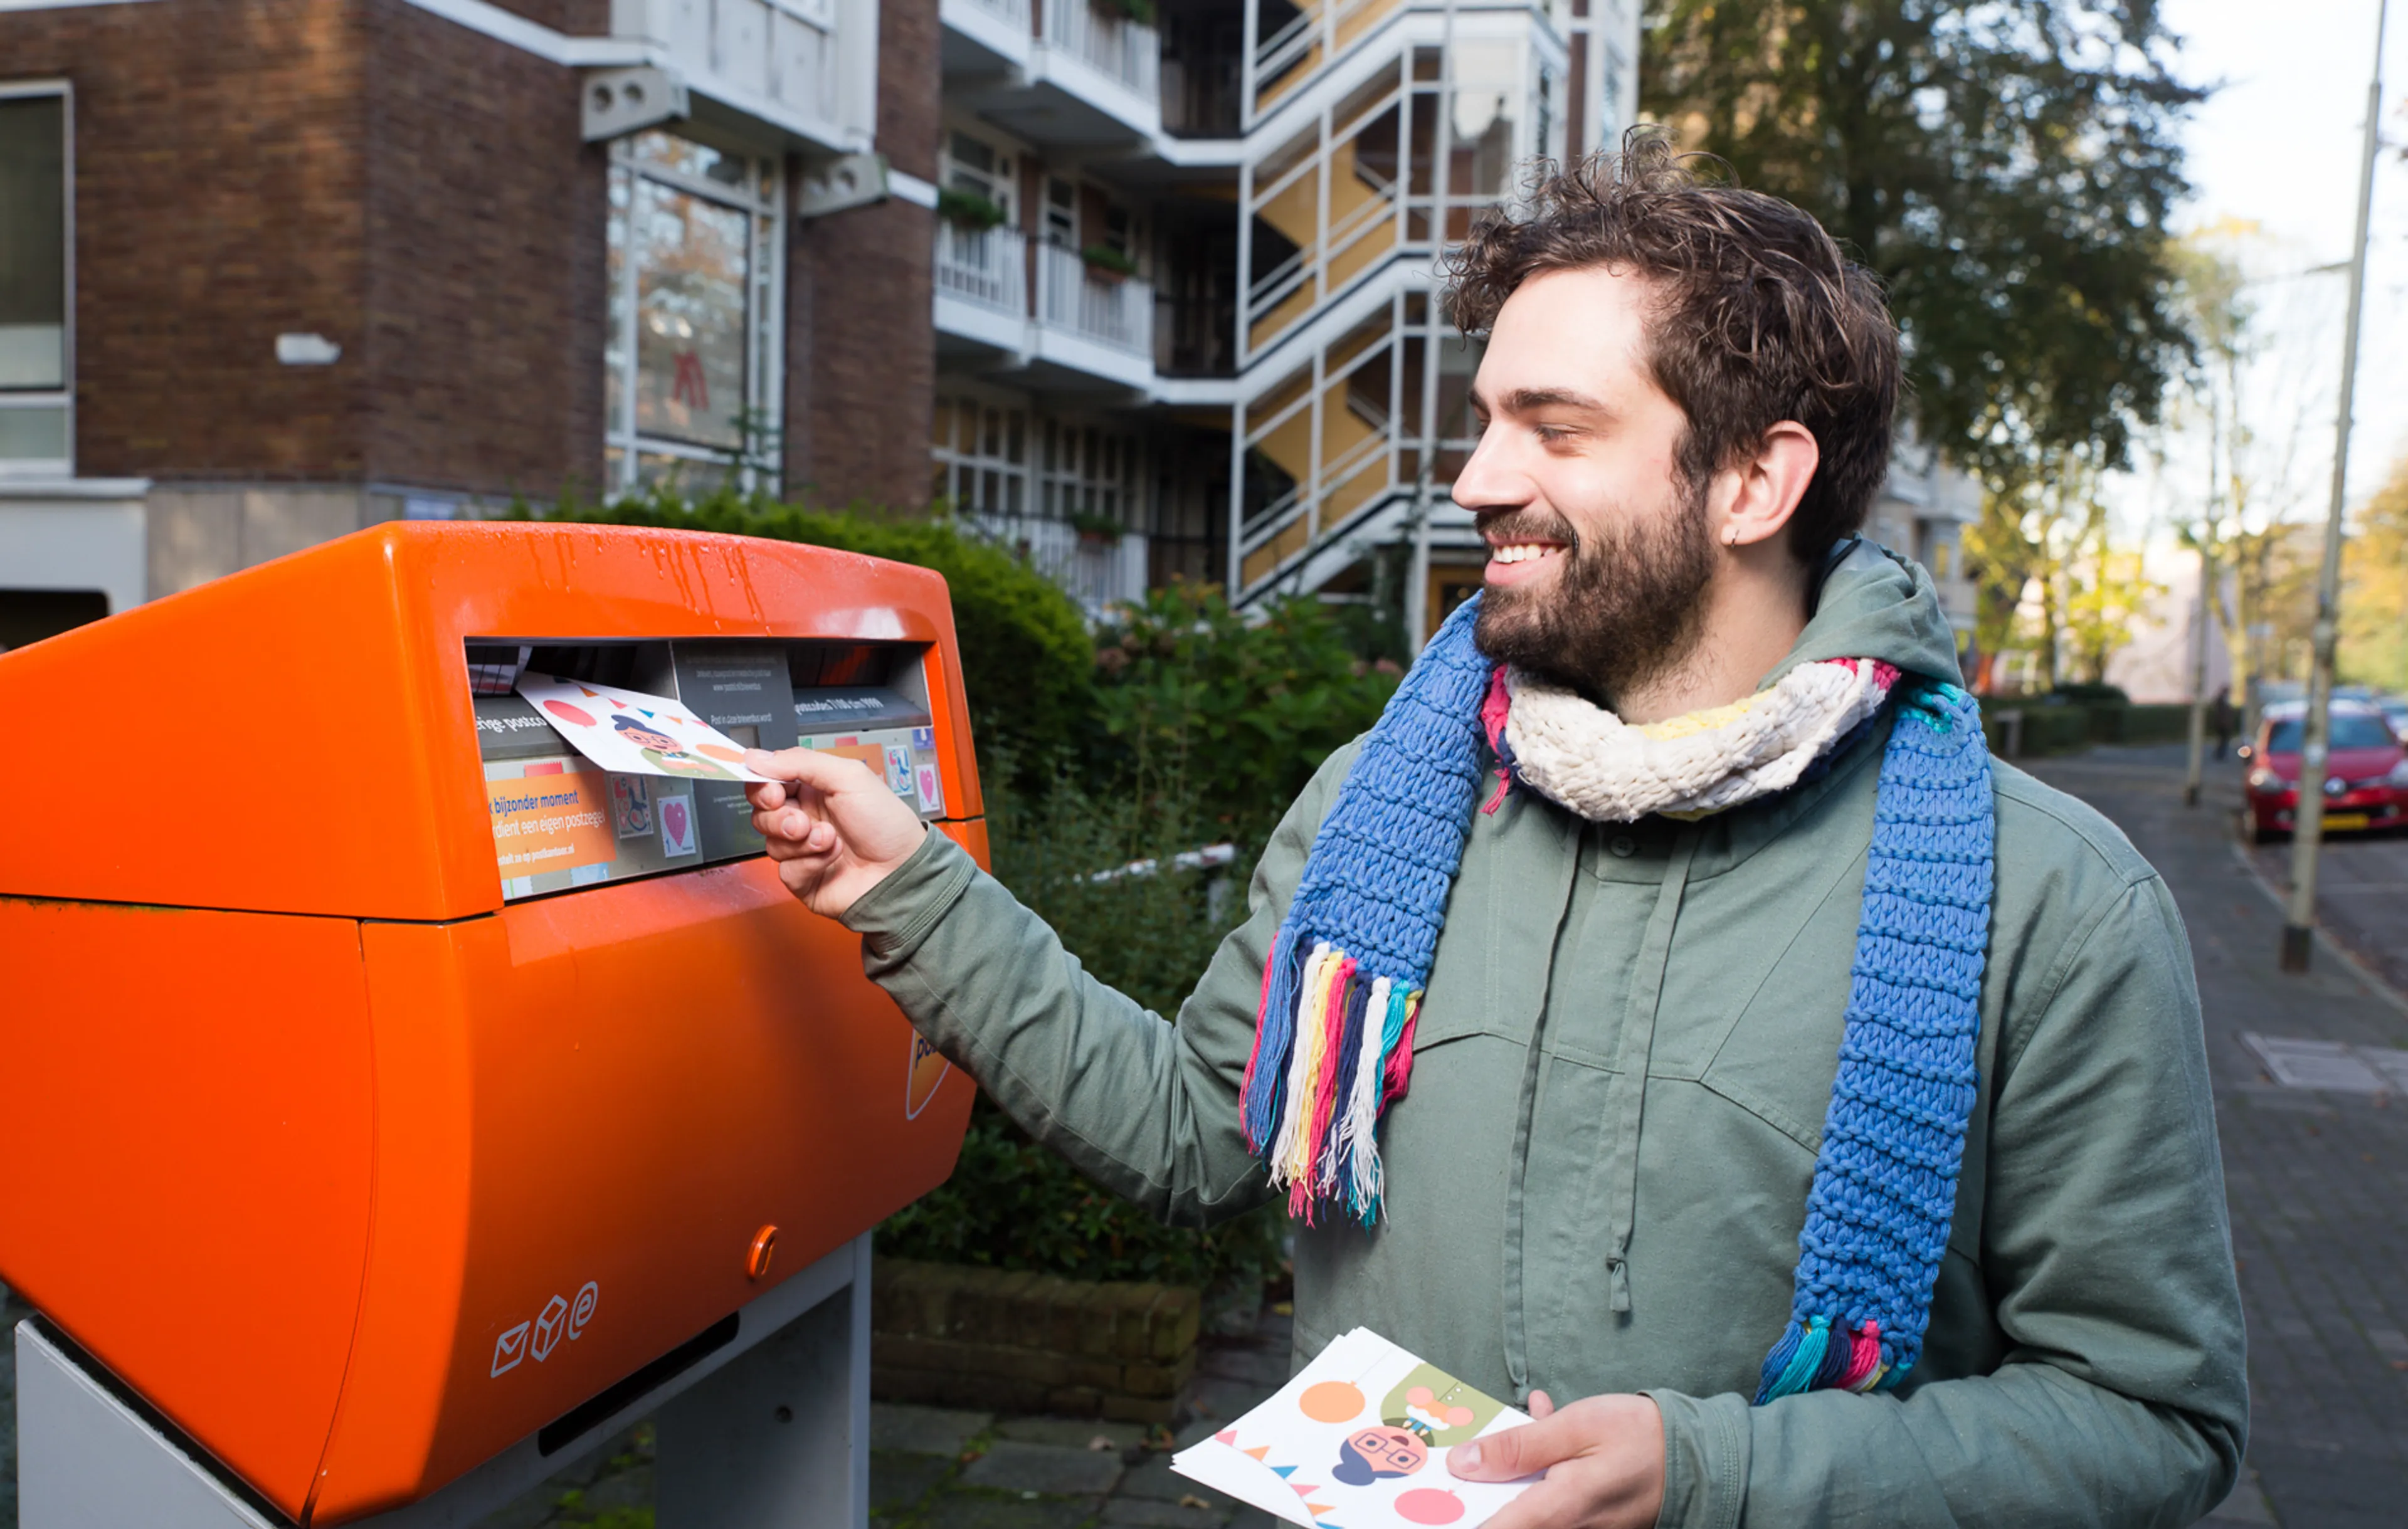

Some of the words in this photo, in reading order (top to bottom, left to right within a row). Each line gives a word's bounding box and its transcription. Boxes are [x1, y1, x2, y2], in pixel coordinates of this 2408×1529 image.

[494, 794, 539, 817] bijzonder
[540, 789, 579, 807] moment
[521, 819, 539, 835] een
[539, 814, 564, 835] eigen
[565, 807, 606, 833] postzegel
